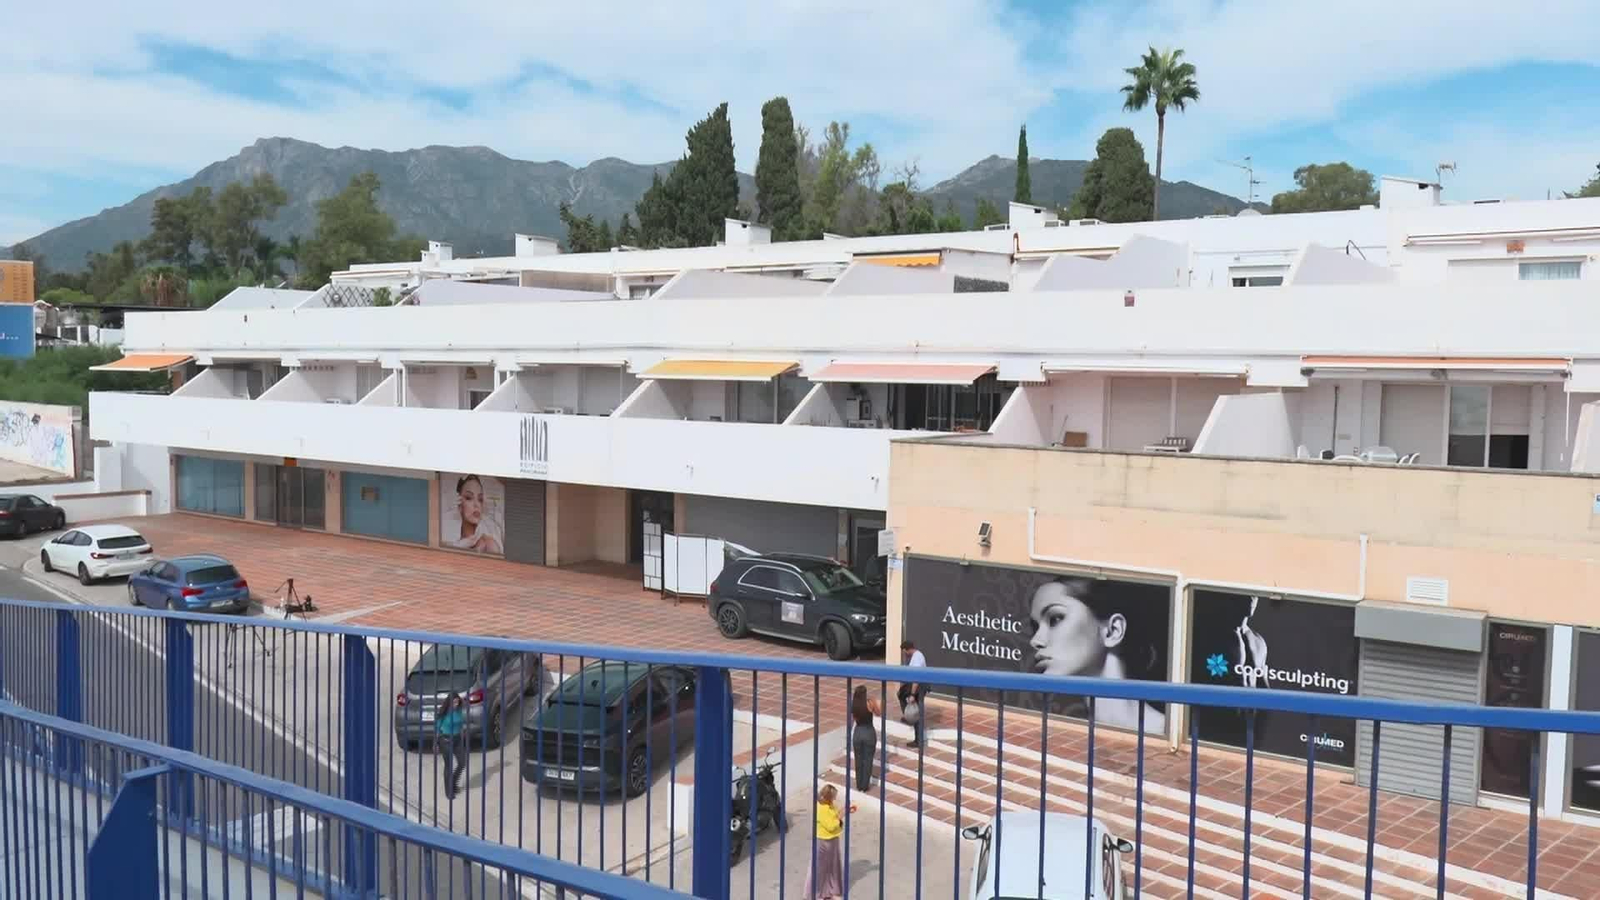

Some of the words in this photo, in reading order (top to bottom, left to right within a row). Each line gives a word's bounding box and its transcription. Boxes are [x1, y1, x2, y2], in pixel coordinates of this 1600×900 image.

[942, 605, 1022, 634] Aesthetic
[941, 631, 1022, 661] Medicine
[1234, 664, 1349, 694] coolsculpting
